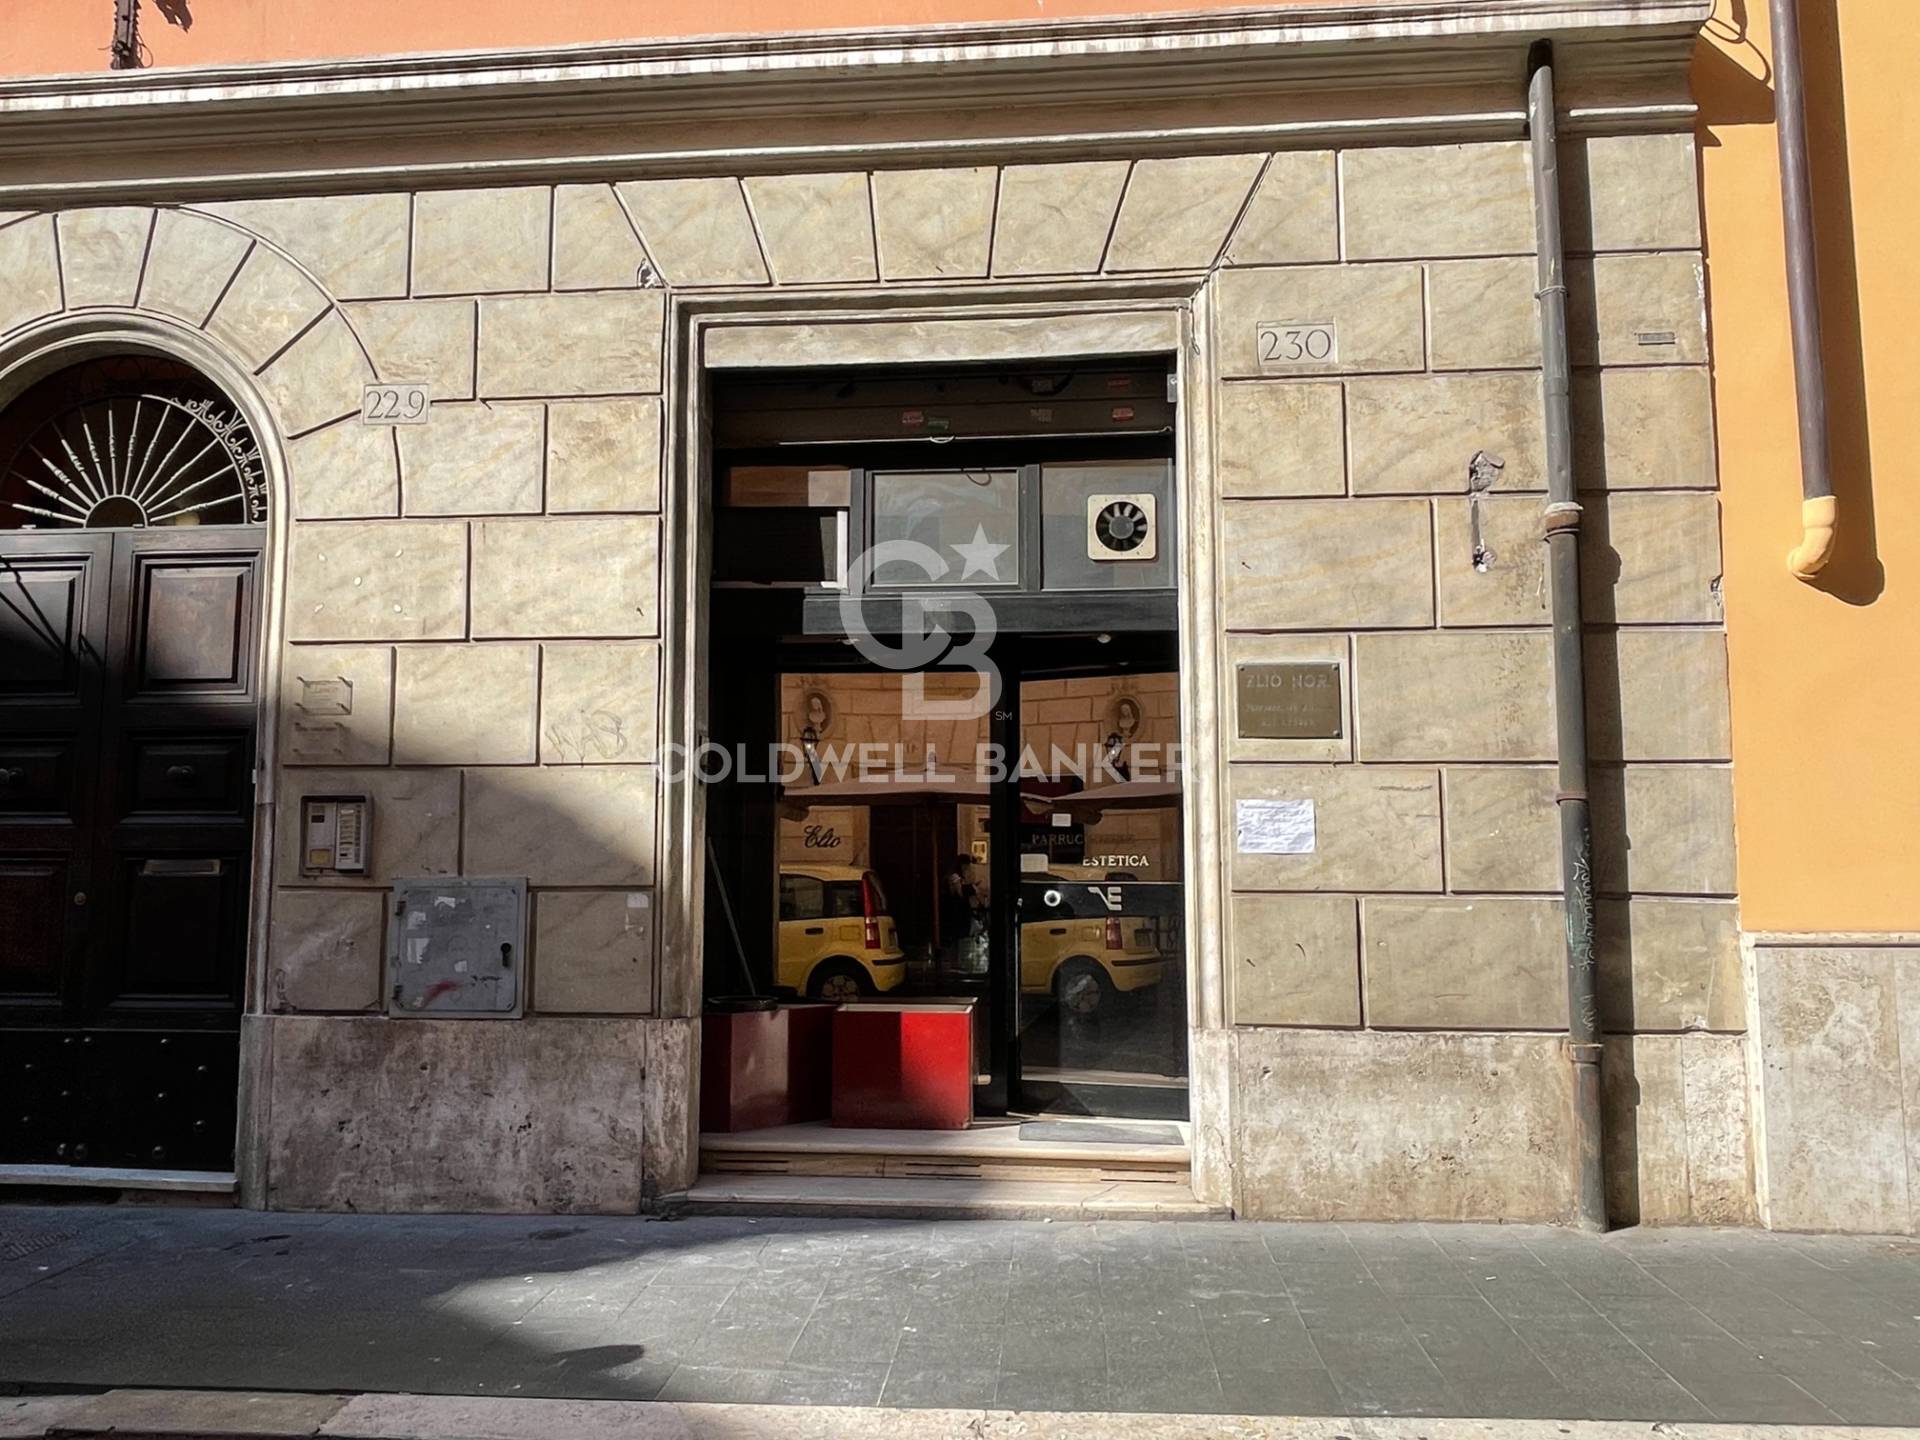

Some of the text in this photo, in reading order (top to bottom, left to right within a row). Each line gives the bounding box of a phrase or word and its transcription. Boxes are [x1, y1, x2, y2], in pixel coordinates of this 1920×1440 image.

[1260, 329, 1332, 362] 230
[366, 390, 426, 419] 229
[803, 825, 841, 848] Elio
[1082, 855, 1150, 867] ESTETICA
